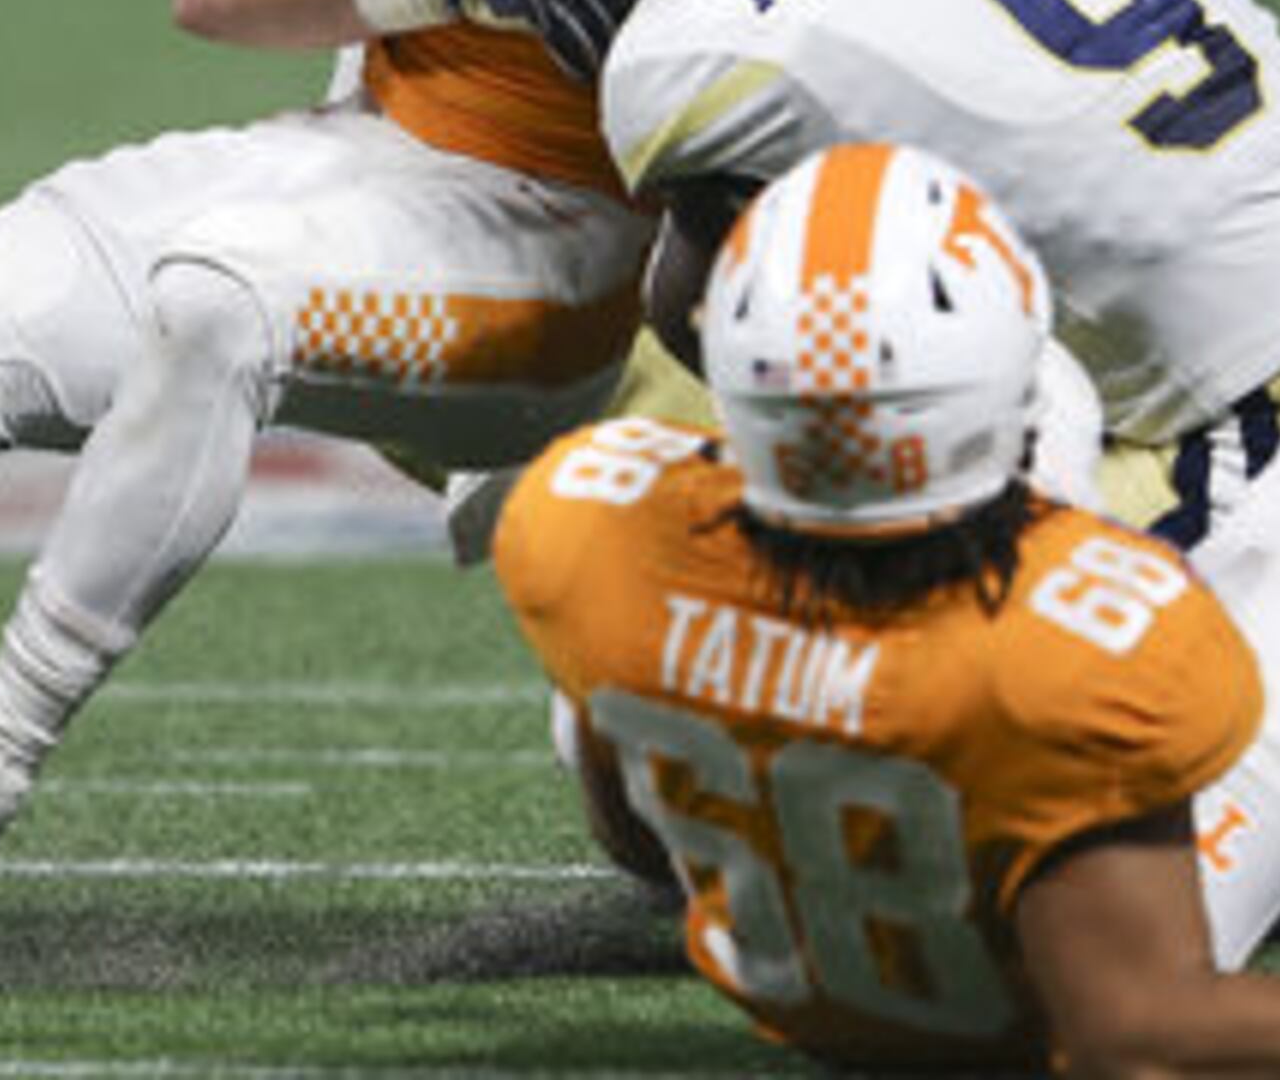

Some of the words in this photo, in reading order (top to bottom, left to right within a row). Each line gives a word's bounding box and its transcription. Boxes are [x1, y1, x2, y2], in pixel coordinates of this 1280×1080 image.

[660, 592, 882, 737] TATUM
[1029, 535, 1189, 658] 68
[588, 684, 1020, 1035] 68
